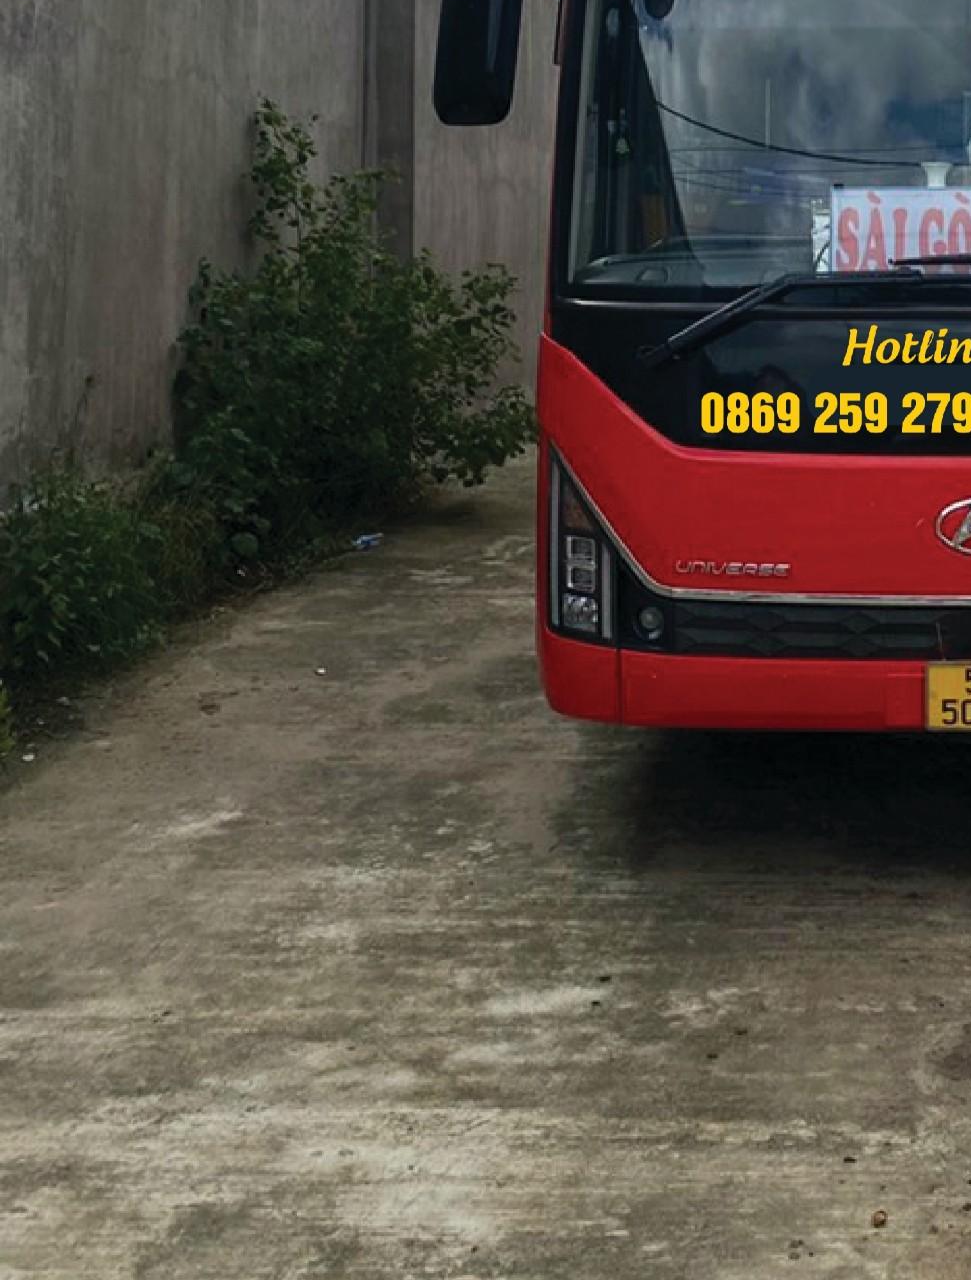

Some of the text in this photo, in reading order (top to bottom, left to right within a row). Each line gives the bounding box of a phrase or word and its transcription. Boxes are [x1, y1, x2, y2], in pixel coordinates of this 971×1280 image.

[701, 391, 800, 434] 0869
[813, 391, 888, 434] 259
[675, 559, 791, 577] UNIVERSE
